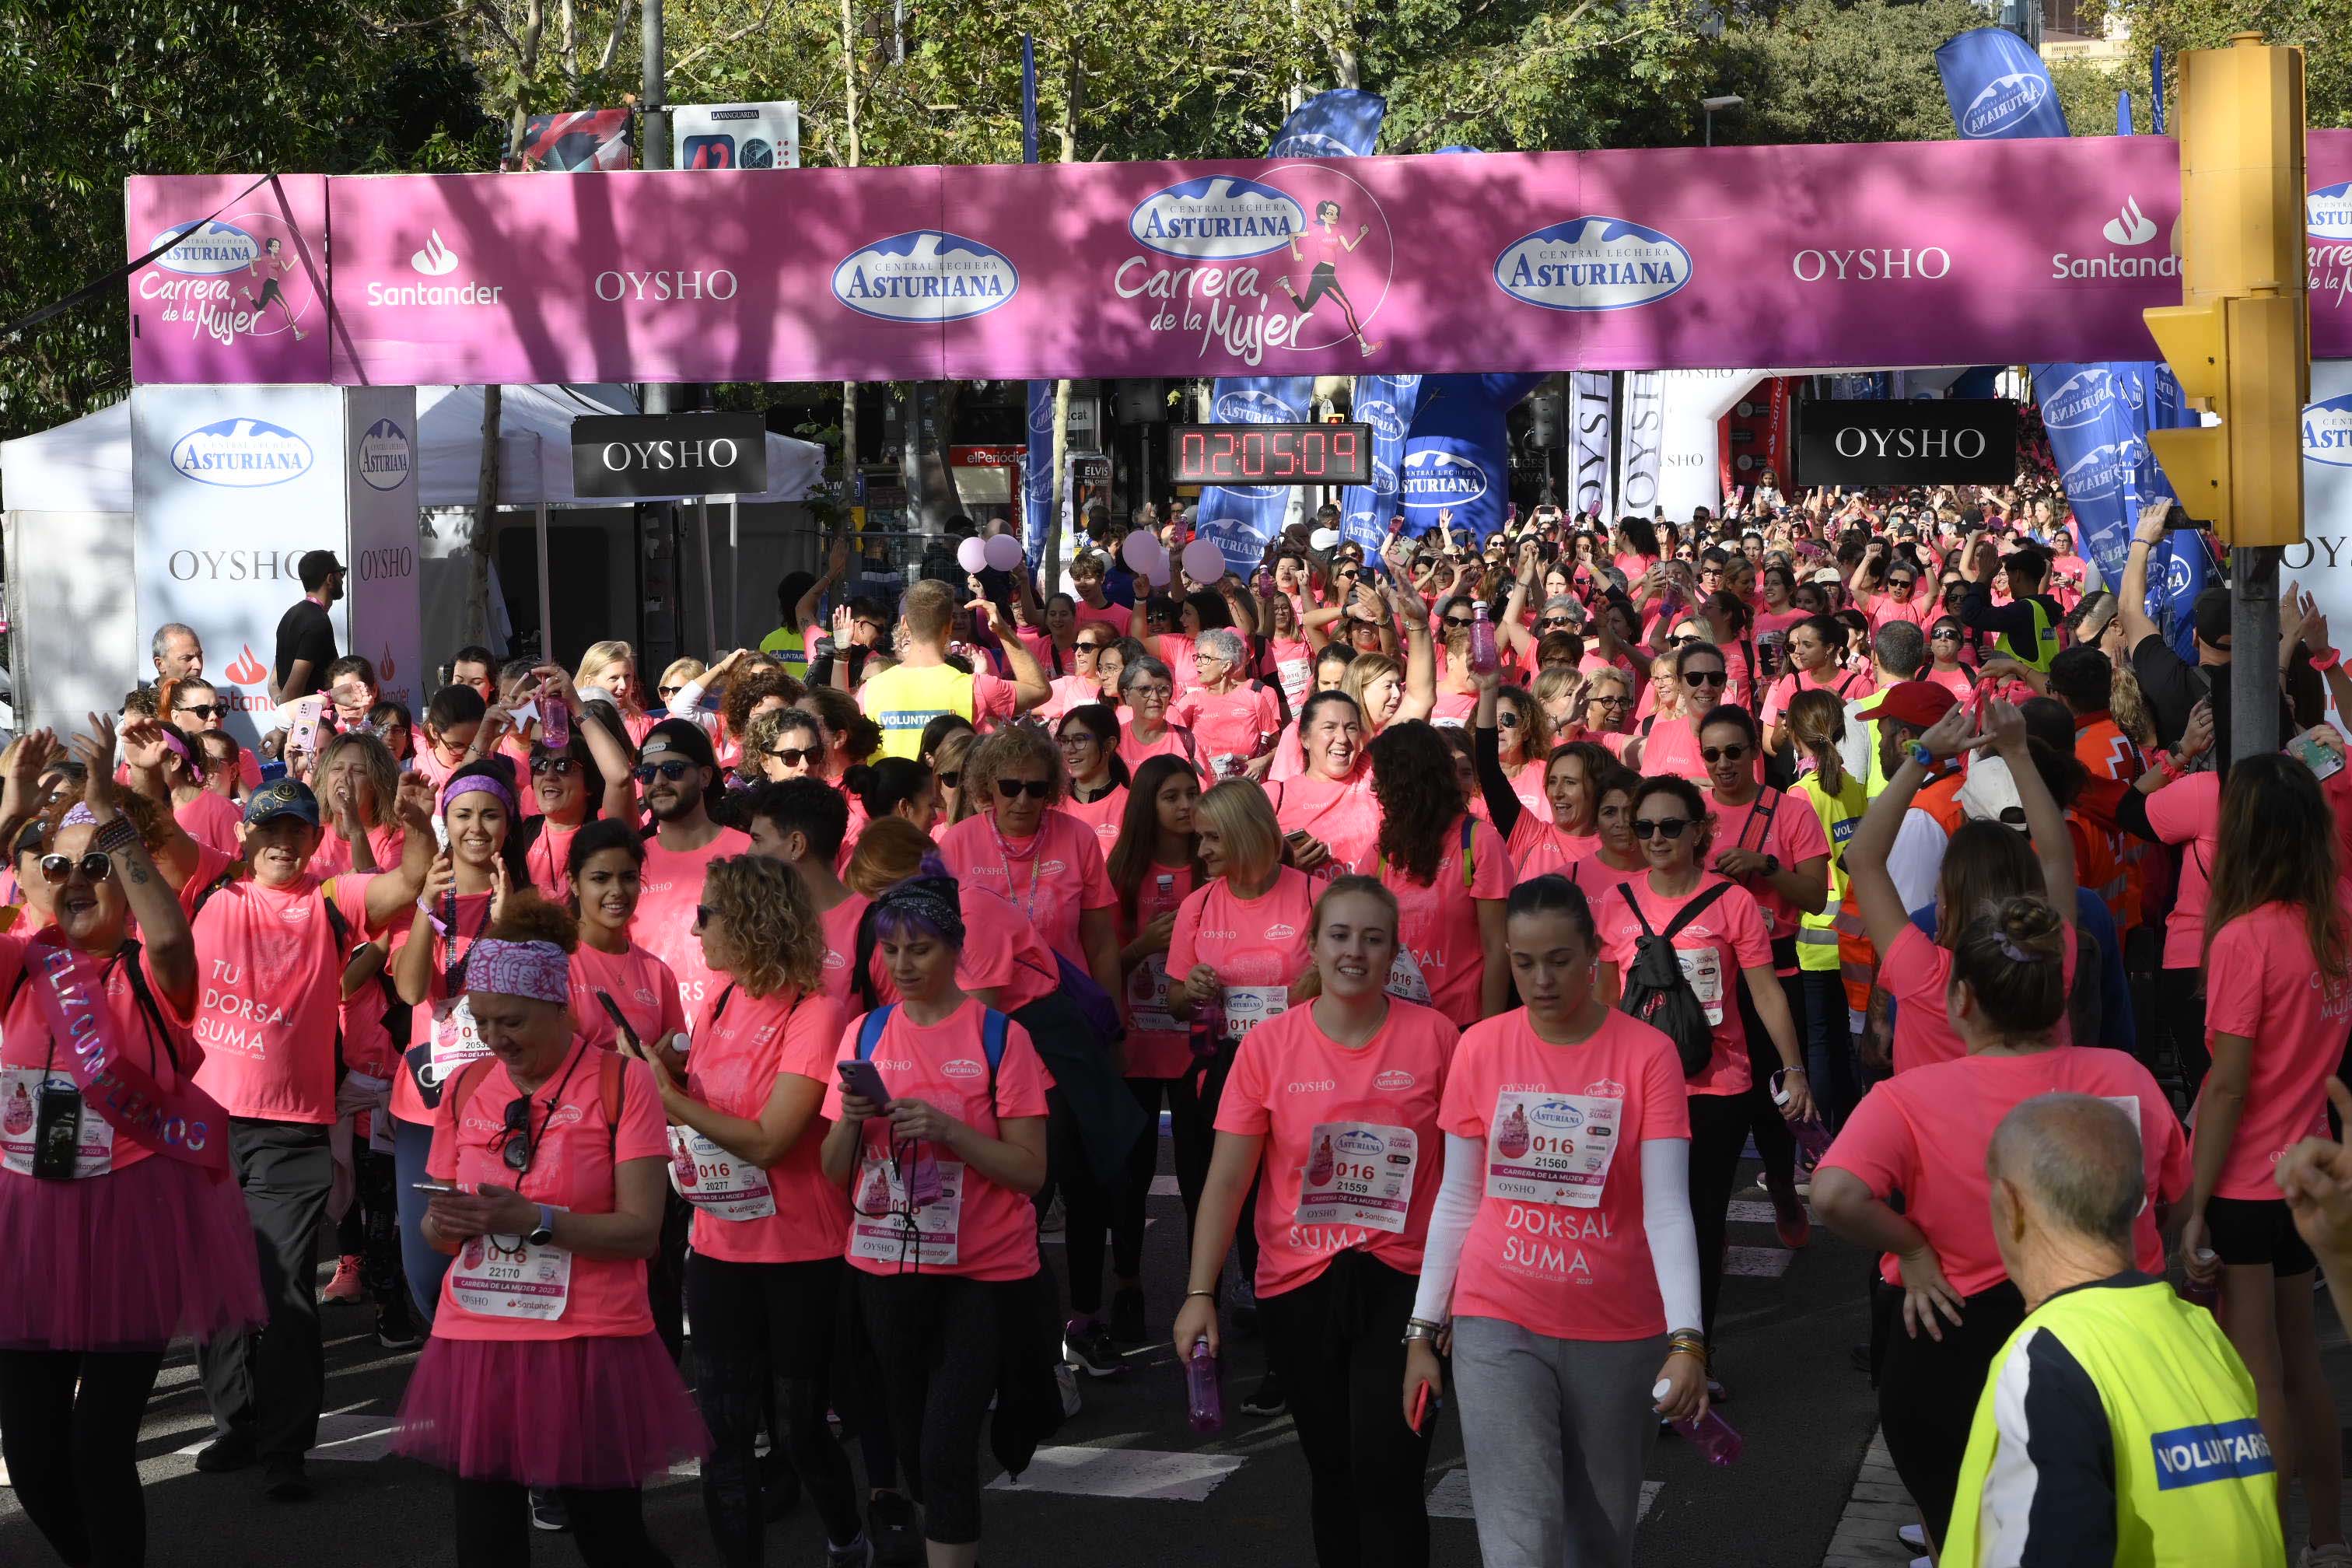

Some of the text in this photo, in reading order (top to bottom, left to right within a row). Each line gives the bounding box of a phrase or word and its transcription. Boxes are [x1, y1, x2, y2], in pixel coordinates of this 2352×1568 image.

[1170, 203, 1288, 214] CENTRAL LECHERA
[1143, 207, 1293, 240] ASTURIANA
[1540, 248, 1669, 259] CENTRAL LECHERA
[875, 261, 998, 271] CENTRAL LECHERA
[1509, 252, 1676, 287] ASTURIANA
[1794, 247, 1950, 282] OYSHO
[139, 271, 231, 299] Carrera
[595, 269, 737, 301] OYSHO
[846, 264, 1004, 299] ASTURIANA
[1114, 256, 1260, 299] Carrera
[367, 282, 502, 306] Santander
[162, 297, 266, 345] de la Mujer
[1150, 293, 1314, 366] de la Mujer
[1836, 427, 1986, 459] OYSHO
[182, 444, 303, 471] ASTURIANA
[362, 448, 408, 473] ASTURIANA
[603, 438, 738, 471] OYSHO
[1181, 432, 1356, 476] 02:05:09
[1085, 467, 1108, 476] ELVIS
[1399, 478, 1480, 494] STURIANA
[360, 547, 412, 583] OYSHO
[212, 959, 240, 985] TU
[1392, 971, 1412, 986] 016
[204, 988, 293, 1027] DORSAL
[198, 1017, 265, 1052] SUMA
[1288, 1080, 1335, 1094] OYSHO
[1534, 1111, 1580, 1124] ASTURIANA
[1338, 1139, 1380, 1152] ASTURIANA
[1533, 1136, 1574, 1154] 016
[699, 1163, 730, 1178] 016
[1336, 1162, 1375, 1180] 016
[1535, 1157, 1568, 1169] 21560
[1503, 1168, 1536, 1178] CARRERA
[705, 1181, 728, 1191] 20277
[1337, 1181, 1367, 1193] 21559
[1499, 1182, 1535, 1195] OYSHO
[734, 1202, 767, 1213] Santander
[1360, 1198, 1382, 1206] MUJER
[1307, 1209, 1337, 1219] OYSHO
[1364, 1212, 1398, 1224] Santander
[1506, 1205, 1613, 1240] DORSAL
[488, 1245, 527, 1264] 016
[863, 1242, 894, 1253] OYSHO
[1503, 1236, 1590, 1275] SUMA
[488, 1267, 520, 1279] 22170
[461, 1280, 489, 1289] CARRERA
[511, 1284, 536, 1293] MUJER
[517, 1298, 557, 1311] Santander
